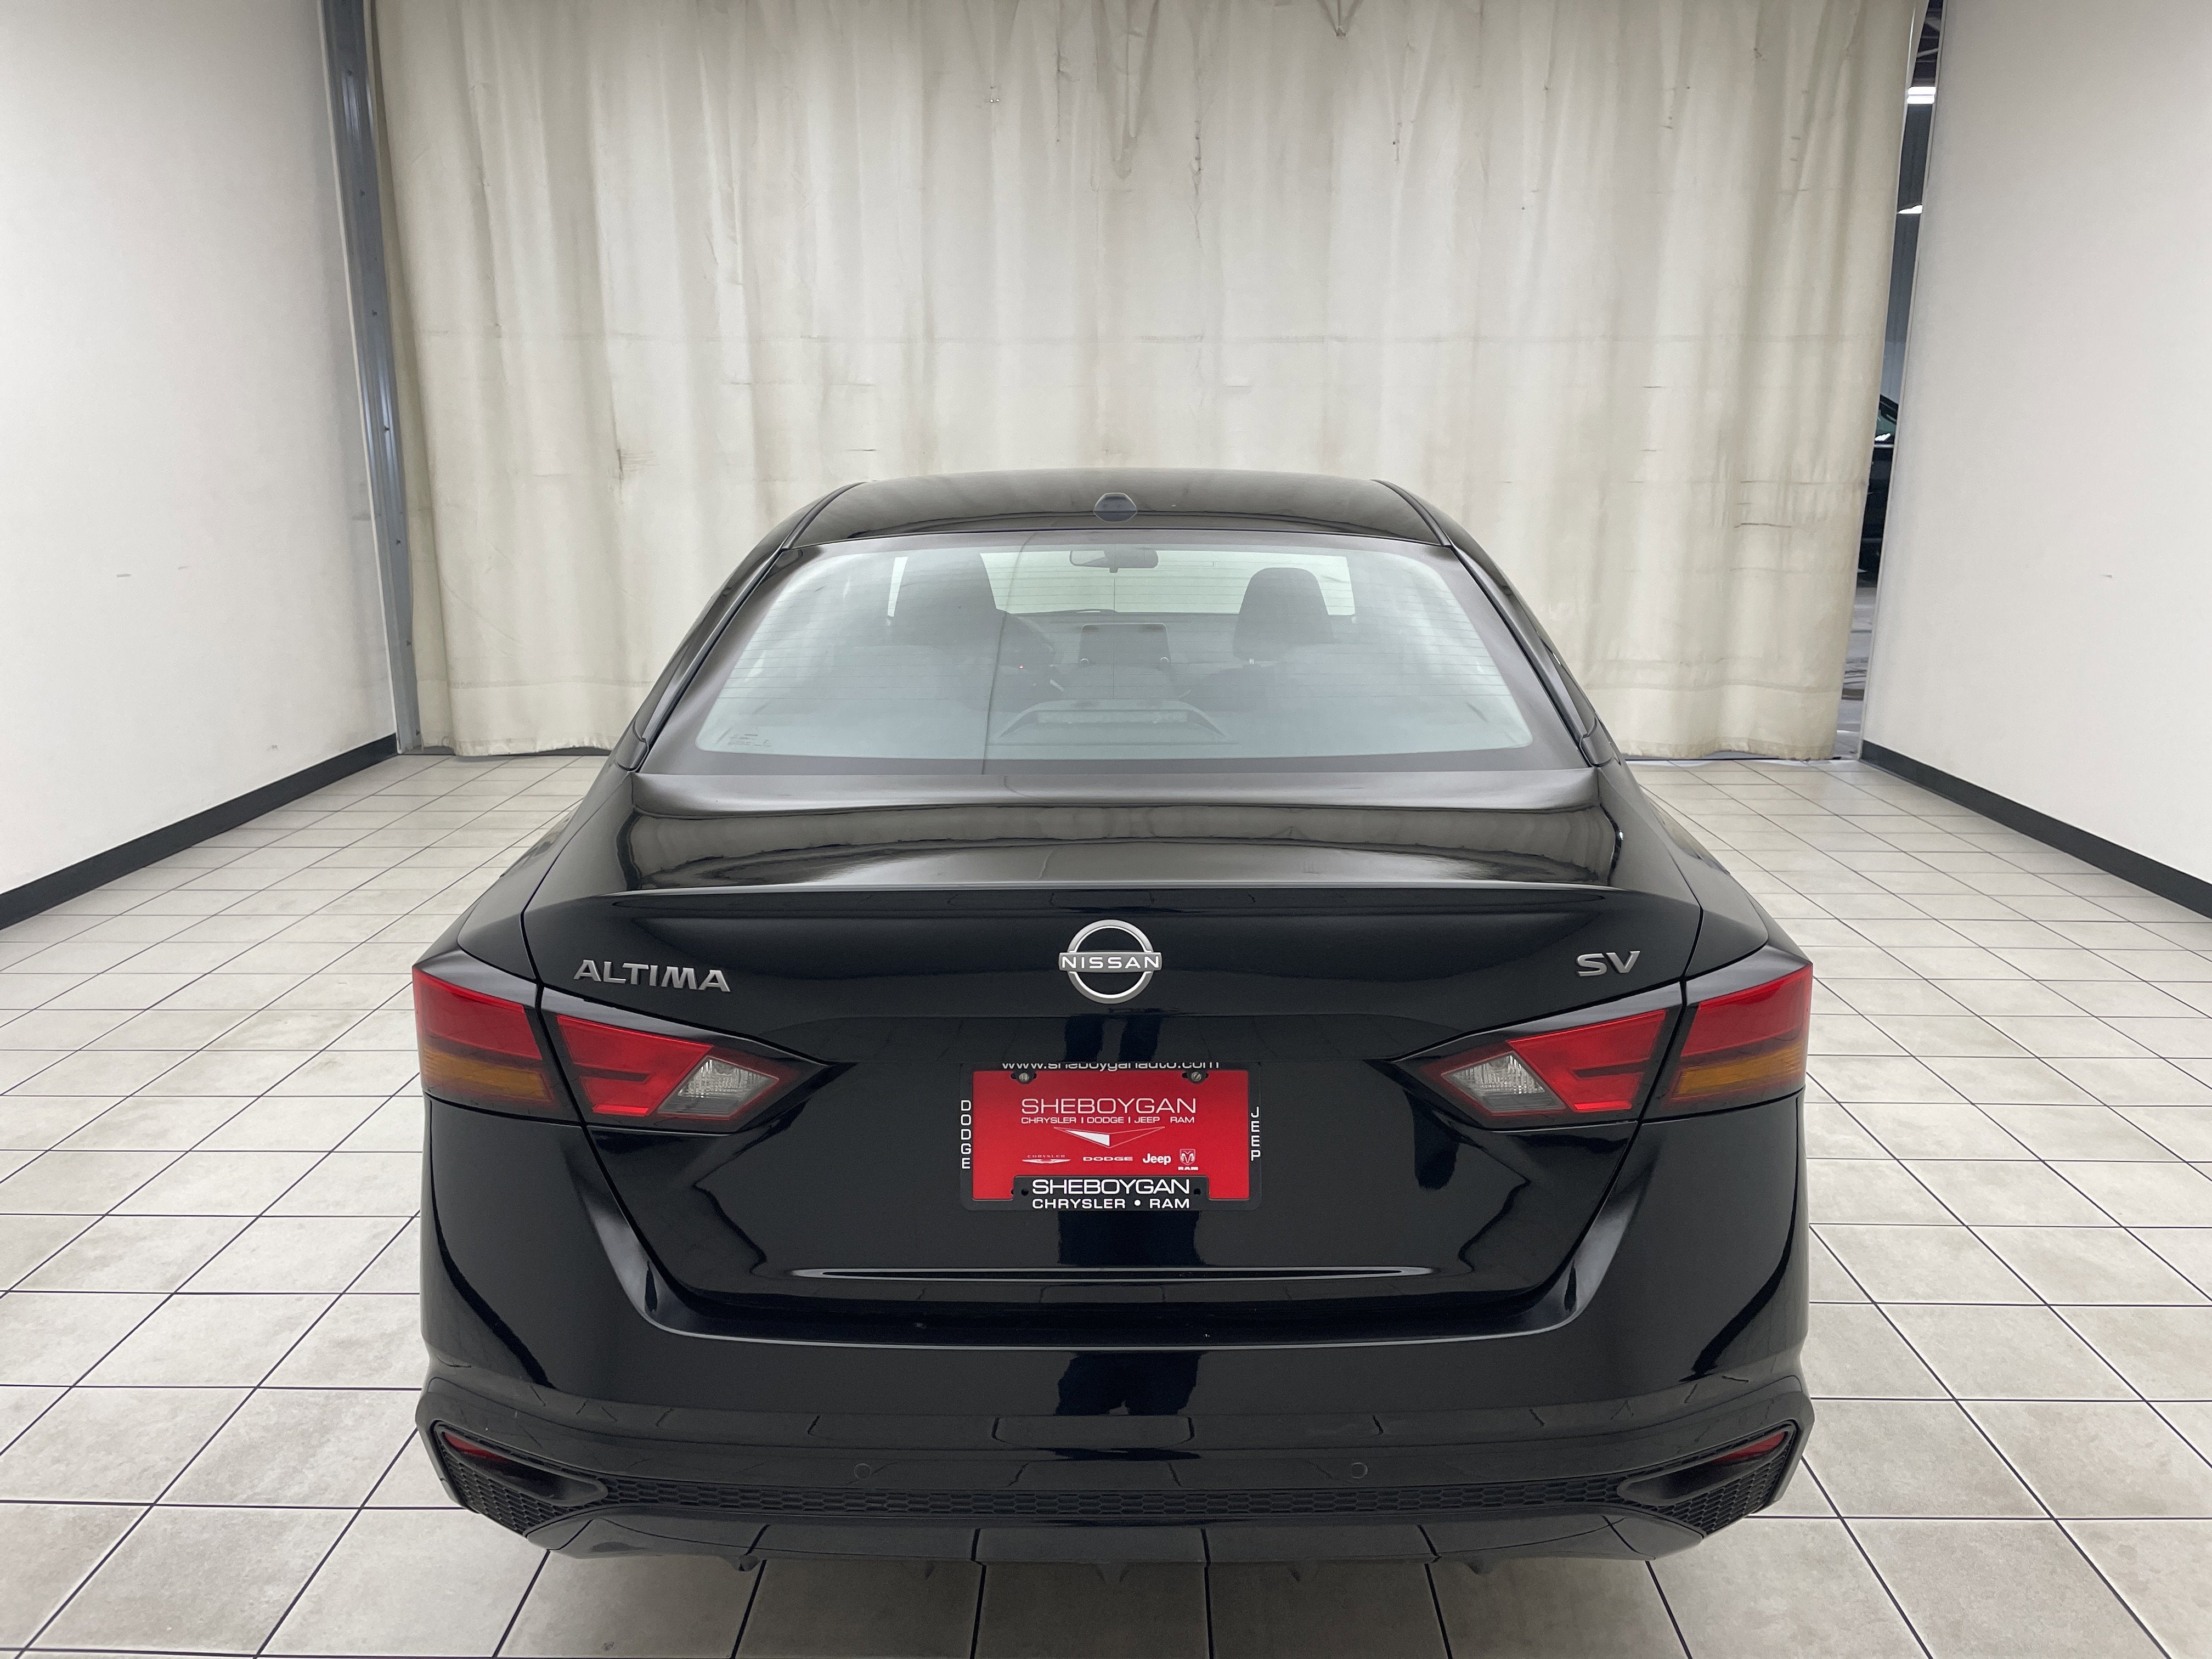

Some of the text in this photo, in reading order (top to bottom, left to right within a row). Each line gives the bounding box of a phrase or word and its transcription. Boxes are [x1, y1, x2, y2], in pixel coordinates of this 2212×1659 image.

[1062, 956, 1159, 969] NISSAN
[1577, 950, 1640, 977] SV
[574, 959, 730, 992] ALTIMA
[1021, 1098, 1196, 1114] SHEBOYGAN
[961, 1099, 972, 1169] DODGE
[1251, 1106, 1261, 1161] JEEP
[1142, 1153, 1171, 1165] Jeep
[1032, 1179, 1189, 1194] SHEBOYGAN
[1032, 1198, 1189, 1209] CHRYSLER RAM
